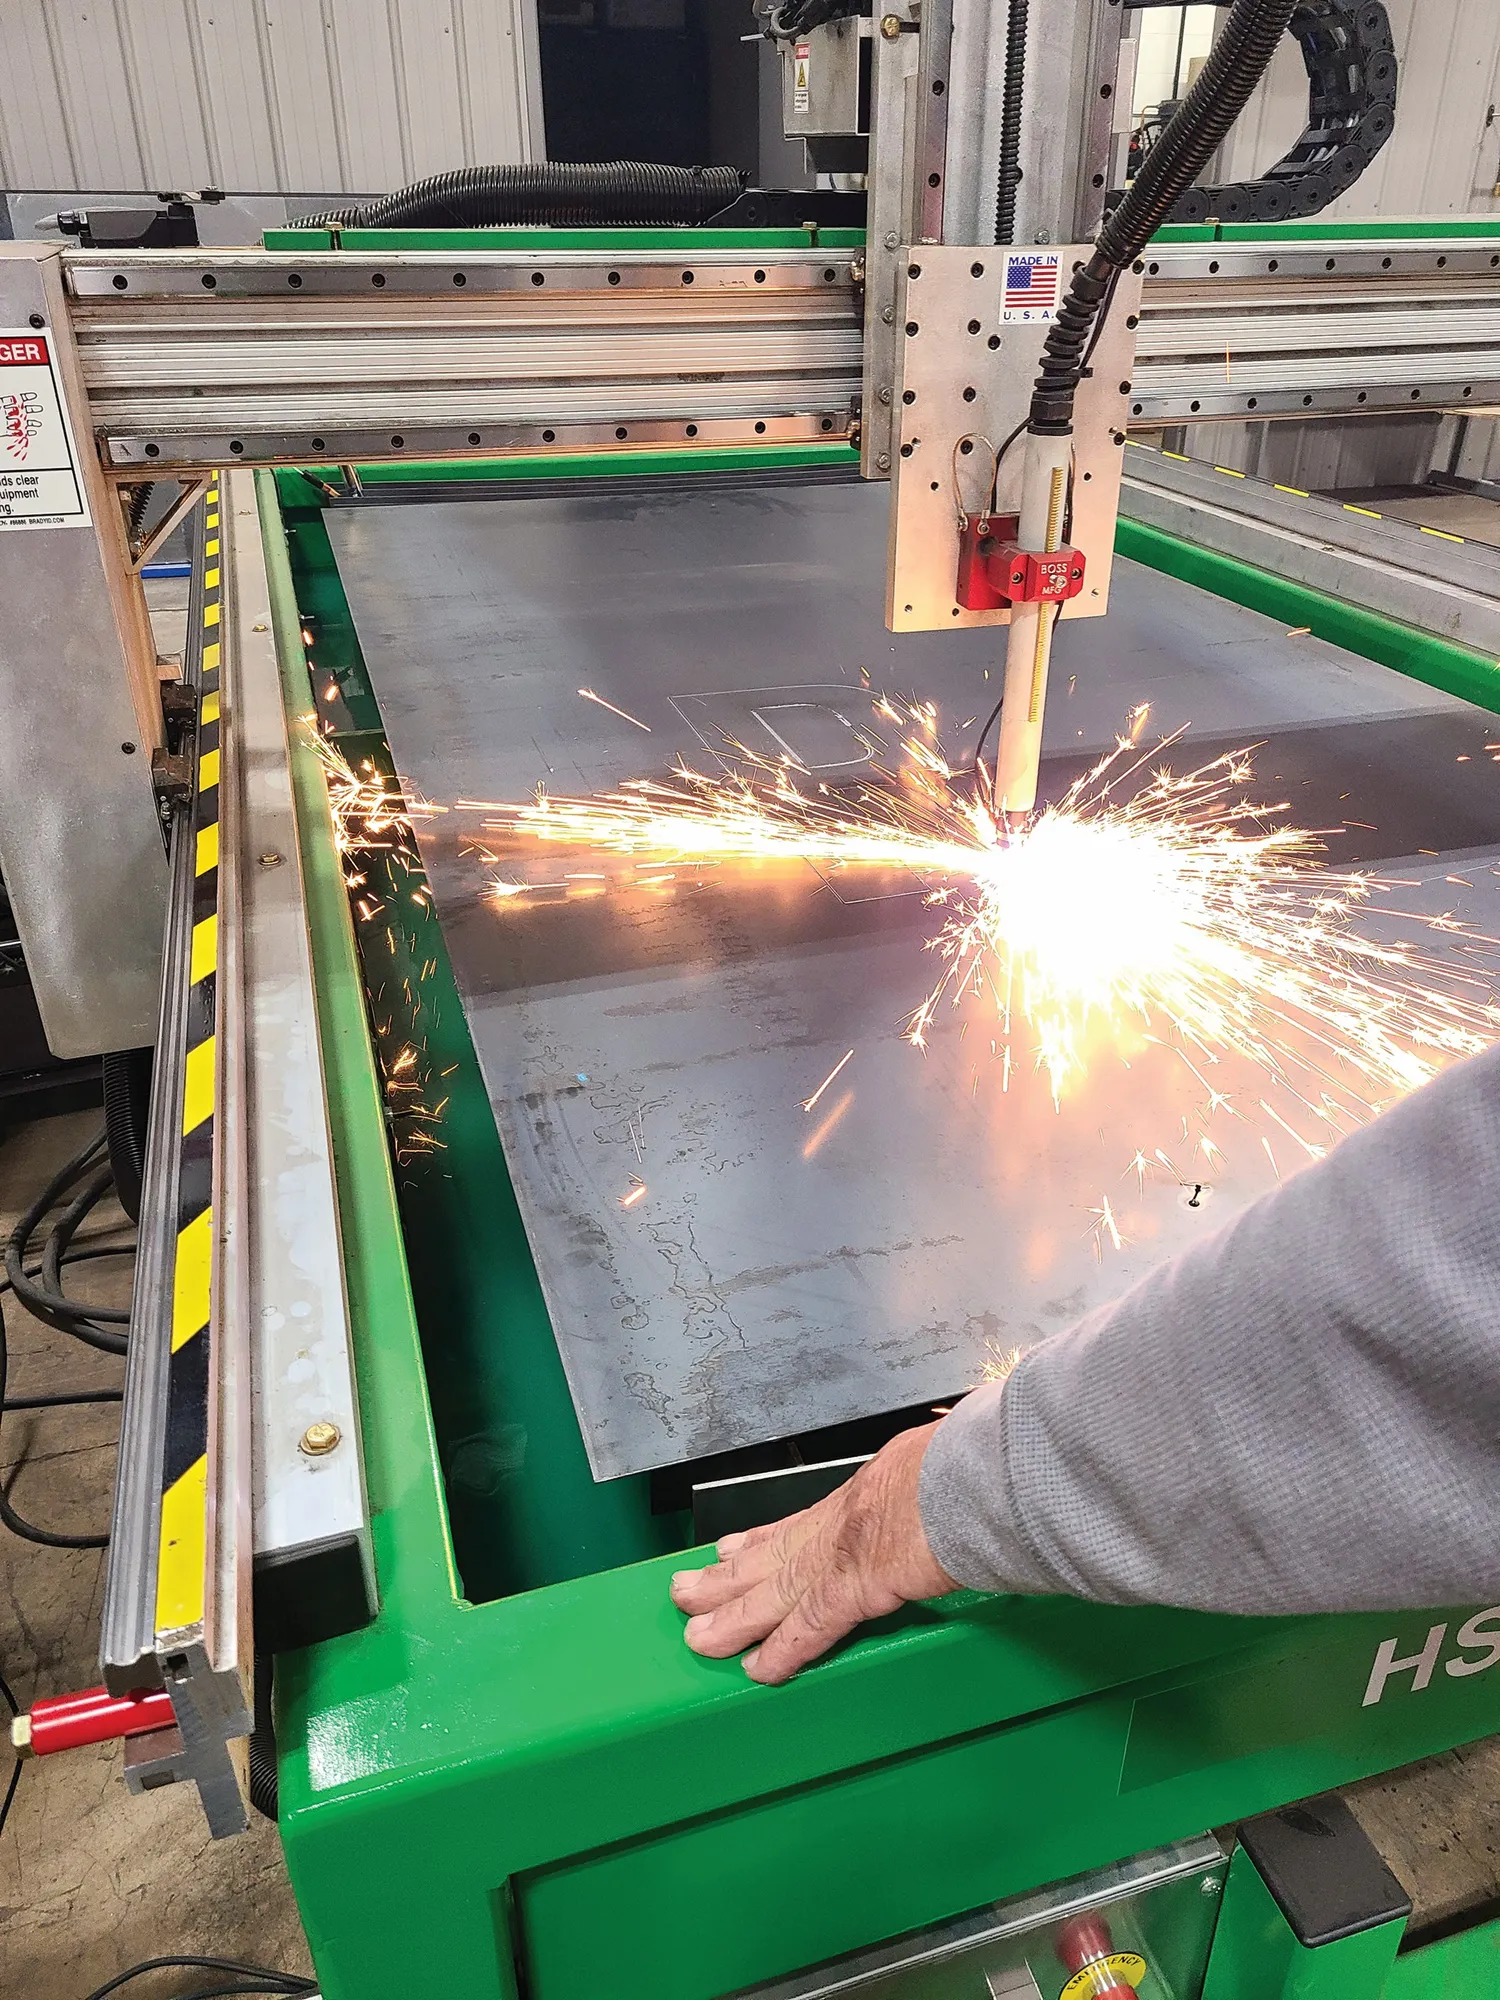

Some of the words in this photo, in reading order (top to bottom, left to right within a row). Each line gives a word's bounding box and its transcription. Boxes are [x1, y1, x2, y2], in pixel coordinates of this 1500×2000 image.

[1008, 256, 1043, 266] MADE
[1046, 256, 1059, 265] IN
[16, 474, 39, 486] clear
[1041, 563, 1067, 575] BOSS
[1361, 1605, 1500, 1708] HS
